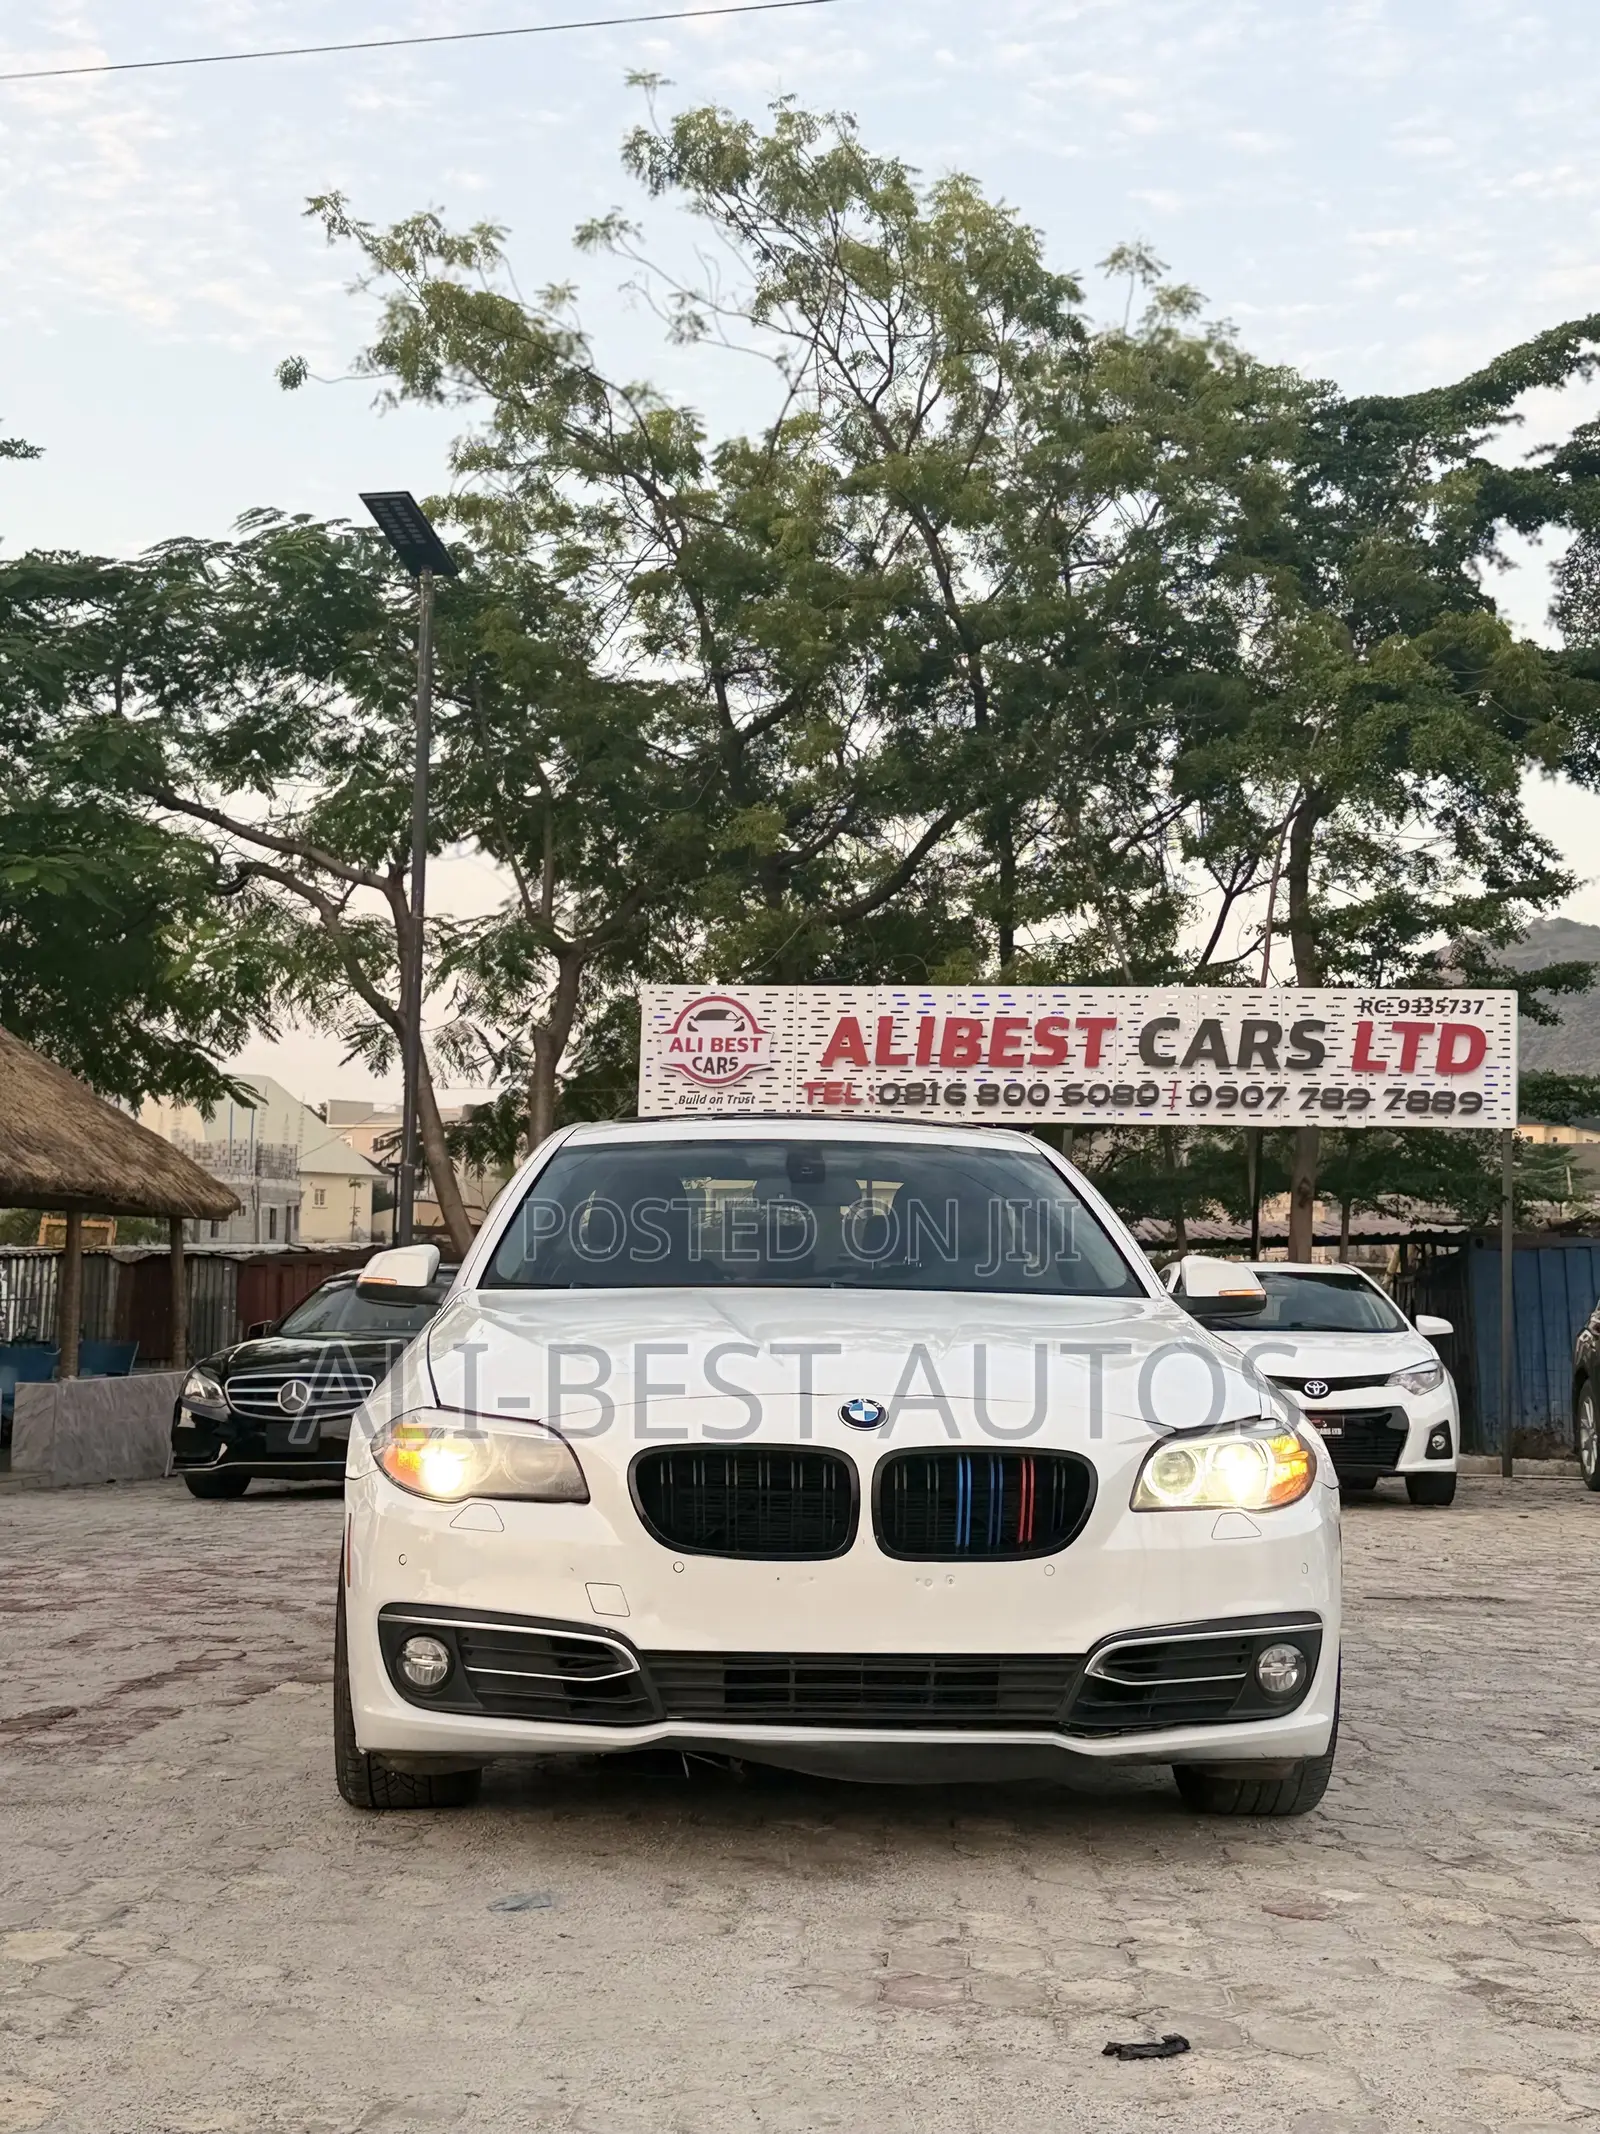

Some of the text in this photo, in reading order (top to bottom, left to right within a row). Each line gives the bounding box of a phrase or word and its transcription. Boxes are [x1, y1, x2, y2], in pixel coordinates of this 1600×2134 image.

[1398, 999, 1485, 1016] 9335737
[668, 1037, 763, 1053] ALI BEST
[820, 1015, 1488, 1076] ALIBEST CARS LTD
[691, 1056, 739, 1075] CARS
[678, 1094, 757, 1106] Build on Trust
[879, 1083, 968, 1106] 0816
[975, 1082, 1051, 1107] 800
[1062, 1083, 1160, 1108] 6080
[1190, 1083, 1288, 1110] 0907
[1298, 1086, 1371, 1111] 789
[1384, 1087, 1484, 1115] 7889
